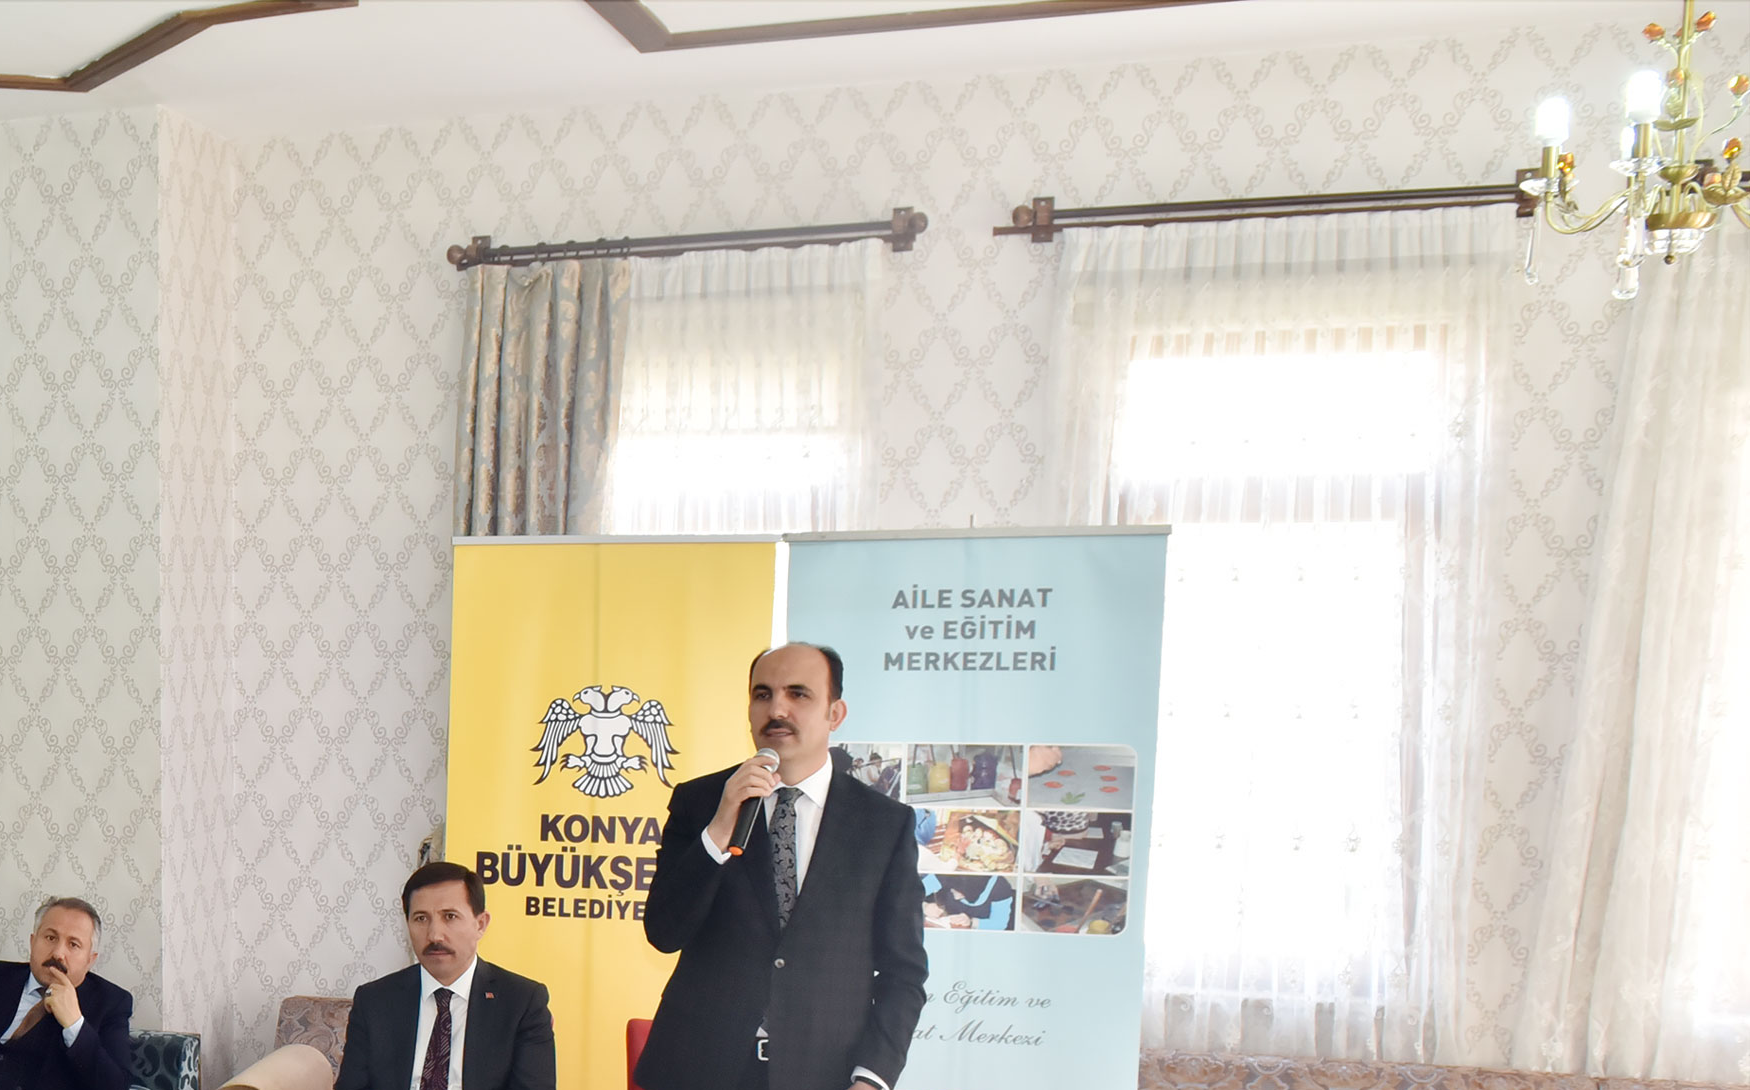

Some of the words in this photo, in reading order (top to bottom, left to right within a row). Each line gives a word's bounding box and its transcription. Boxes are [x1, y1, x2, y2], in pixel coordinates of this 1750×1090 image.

[891, 584, 953, 609] AİLE
[960, 588, 1053, 609] SANAT
[905, 625, 935, 640] ve
[943, 615, 1036, 640] EĞİTİM
[884, 646, 1056, 671] MERKEZLERİ
[540, 814, 662, 845] KONYA
[476, 844, 658, 896] BÜYÜKŞE
[525, 894, 647, 921] BELEDİYE
[943, 980, 1019, 1014] Eğitim
[1025, 997, 1051, 1009] ve
[940, 1019, 1047, 1047] Merkezi
